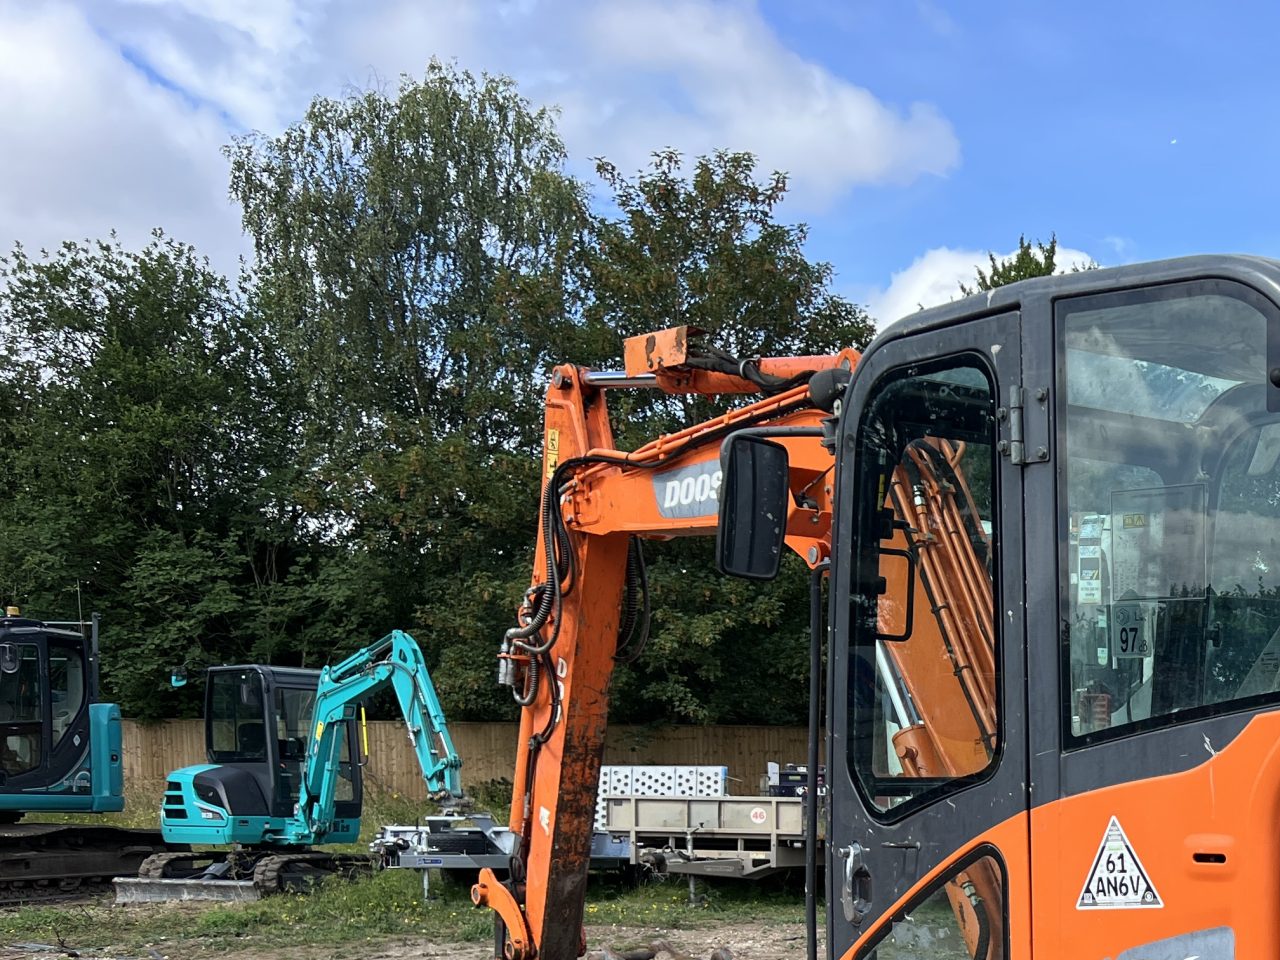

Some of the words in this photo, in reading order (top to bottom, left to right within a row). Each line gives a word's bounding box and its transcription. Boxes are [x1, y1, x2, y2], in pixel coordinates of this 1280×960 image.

[664, 470, 723, 508] DOOS
[1120, 627, 1138, 652] 97
[752, 811, 765, 820] 46
[1106, 853, 1127, 873] 61
[1096, 876, 1140, 897] AN6V
